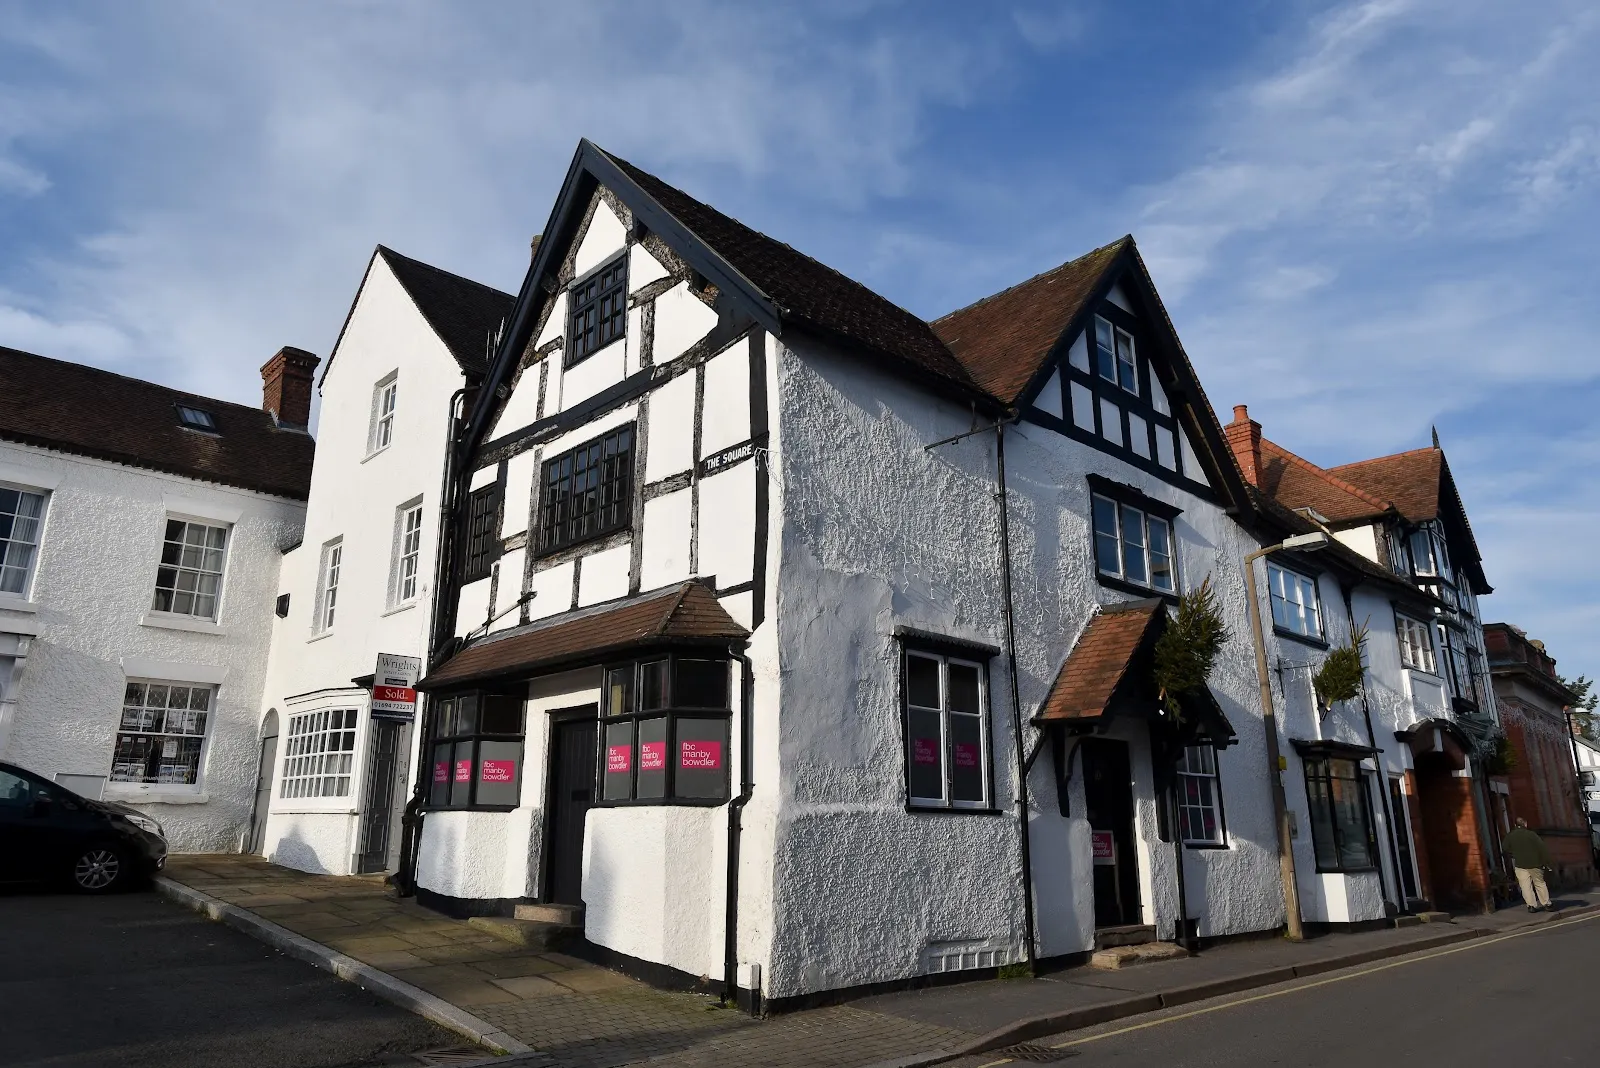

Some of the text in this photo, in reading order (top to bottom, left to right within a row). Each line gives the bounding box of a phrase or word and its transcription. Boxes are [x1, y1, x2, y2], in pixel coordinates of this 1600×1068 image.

[706, 456, 721, 470] THE
[382, 657, 417, 671] Wrights
[384, 688, 406, 700] Sold
[642, 744, 651, 752] fbc
[682, 742, 696, 750] fbc
[609, 747, 617, 755] fbc
[682, 750, 711, 759] manby
[608, 754, 625, 762] manby
[642, 752, 659, 760] manby
[641, 759, 662, 767] bowdler
[682, 757, 716, 766] bowdler
[608, 762, 628, 770] bowdler
[483, 767, 507, 775] manby
[483, 773, 510, 781] bowdler
